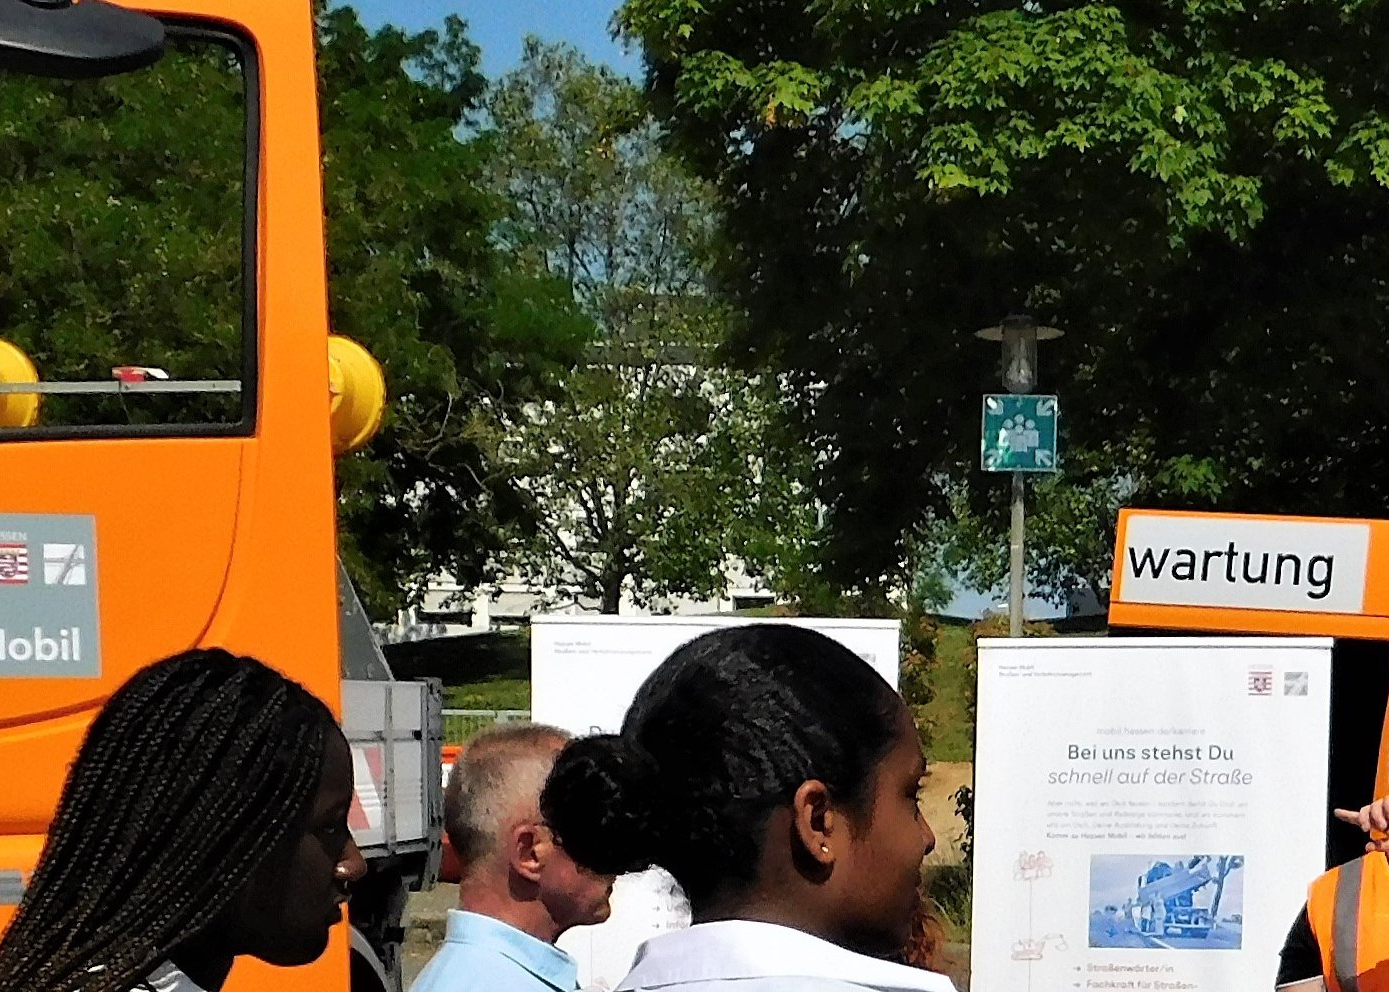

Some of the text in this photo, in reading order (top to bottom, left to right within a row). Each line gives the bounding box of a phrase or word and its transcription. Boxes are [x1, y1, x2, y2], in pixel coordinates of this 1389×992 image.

[1128, 541, 1334, 600] wartung
[1068, 744, 1234, 761] Bei uns stehst Du
[1047, 767, 1253, 785] schnell auf der Straße
[1086, 979, 1134, 989] Fachkraft
[1137, 980, 1152, 989] für
